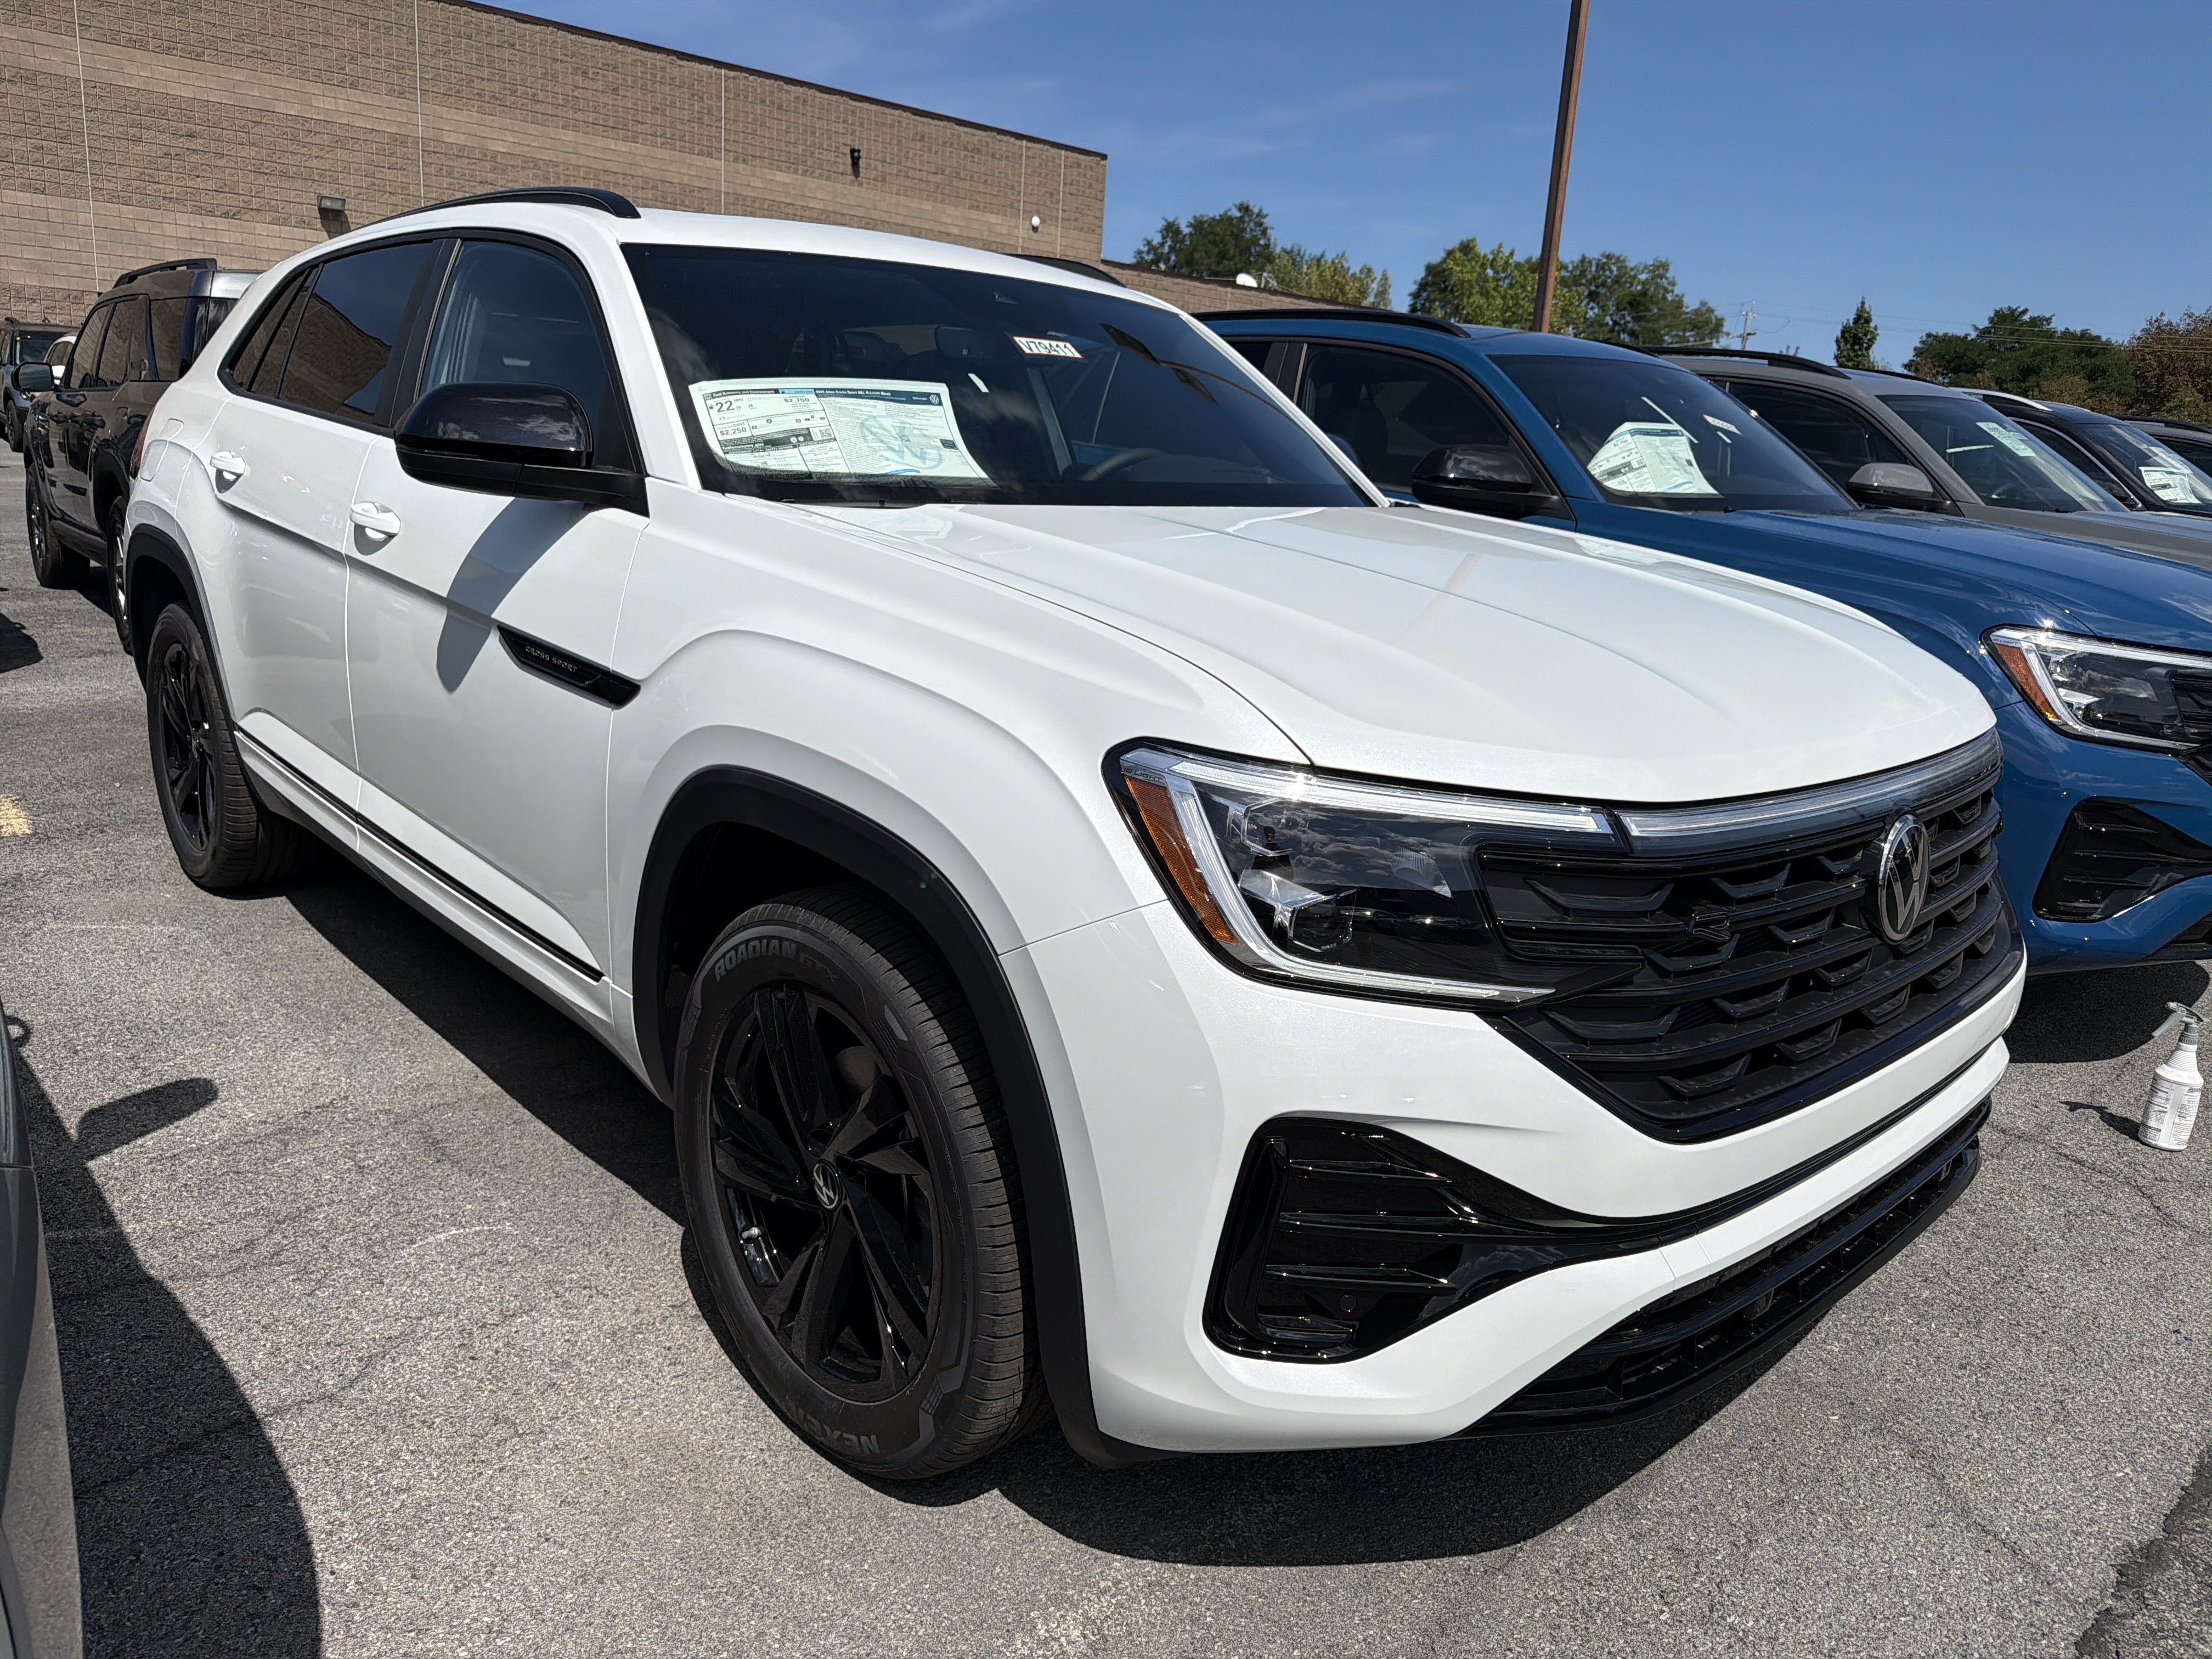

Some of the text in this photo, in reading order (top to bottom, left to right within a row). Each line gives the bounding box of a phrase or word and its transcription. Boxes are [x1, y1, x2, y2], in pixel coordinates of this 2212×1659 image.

[1018, 338, 1076, 357] V79411
[715, 400, 735, 413] 22
[719, 426, 747, 436] $2,250
[526, 646, 578, 673] CROSS SPORT
[1124, 767, 1163, 782] IQ.LIGHT
[713, 938, 798, 983] ROADIAN
